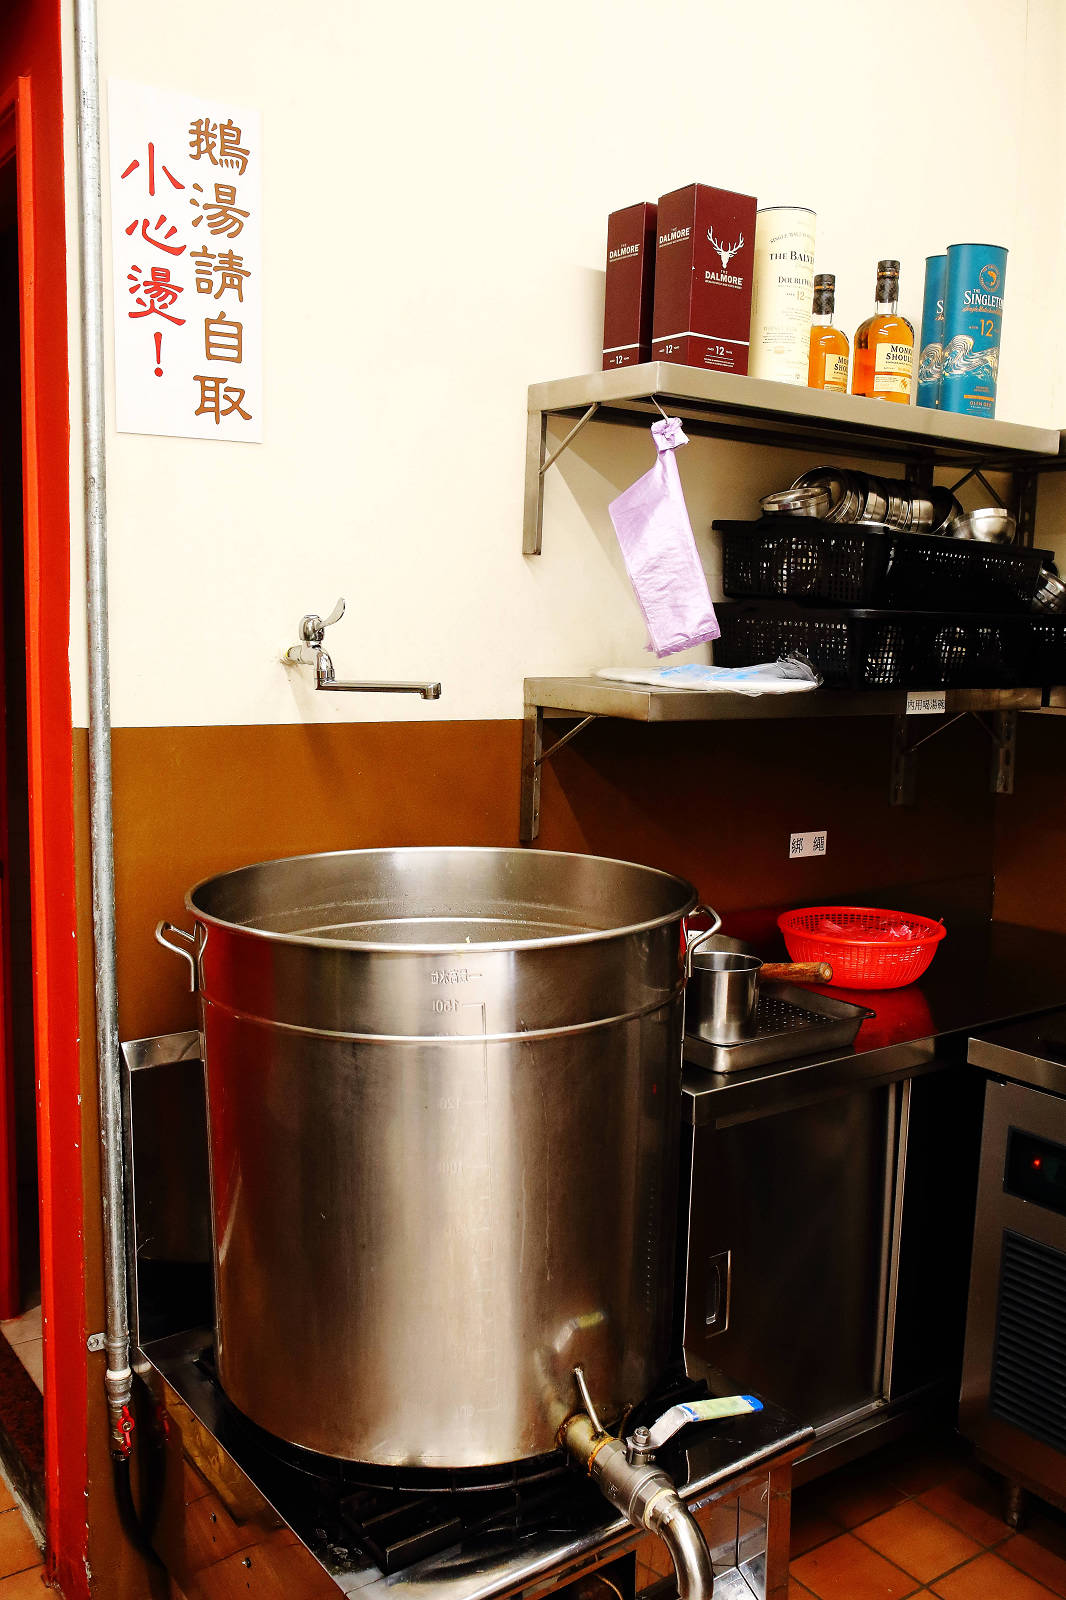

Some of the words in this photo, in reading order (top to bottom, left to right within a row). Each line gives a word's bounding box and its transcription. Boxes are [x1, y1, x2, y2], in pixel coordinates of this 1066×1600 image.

[659, 227, 691, 244] DALMORE
[609, 245, 639, 259] DALMORE
[189, 118, 252, 425] 鵝湯請自取
[705, 271, 743, 286] DALMORE
[980, 319, 994, 337] 12
[666, 345, 673, 354] 12
[716, 346, 724, 356] 12
[616, 355, 623, 364] 12
